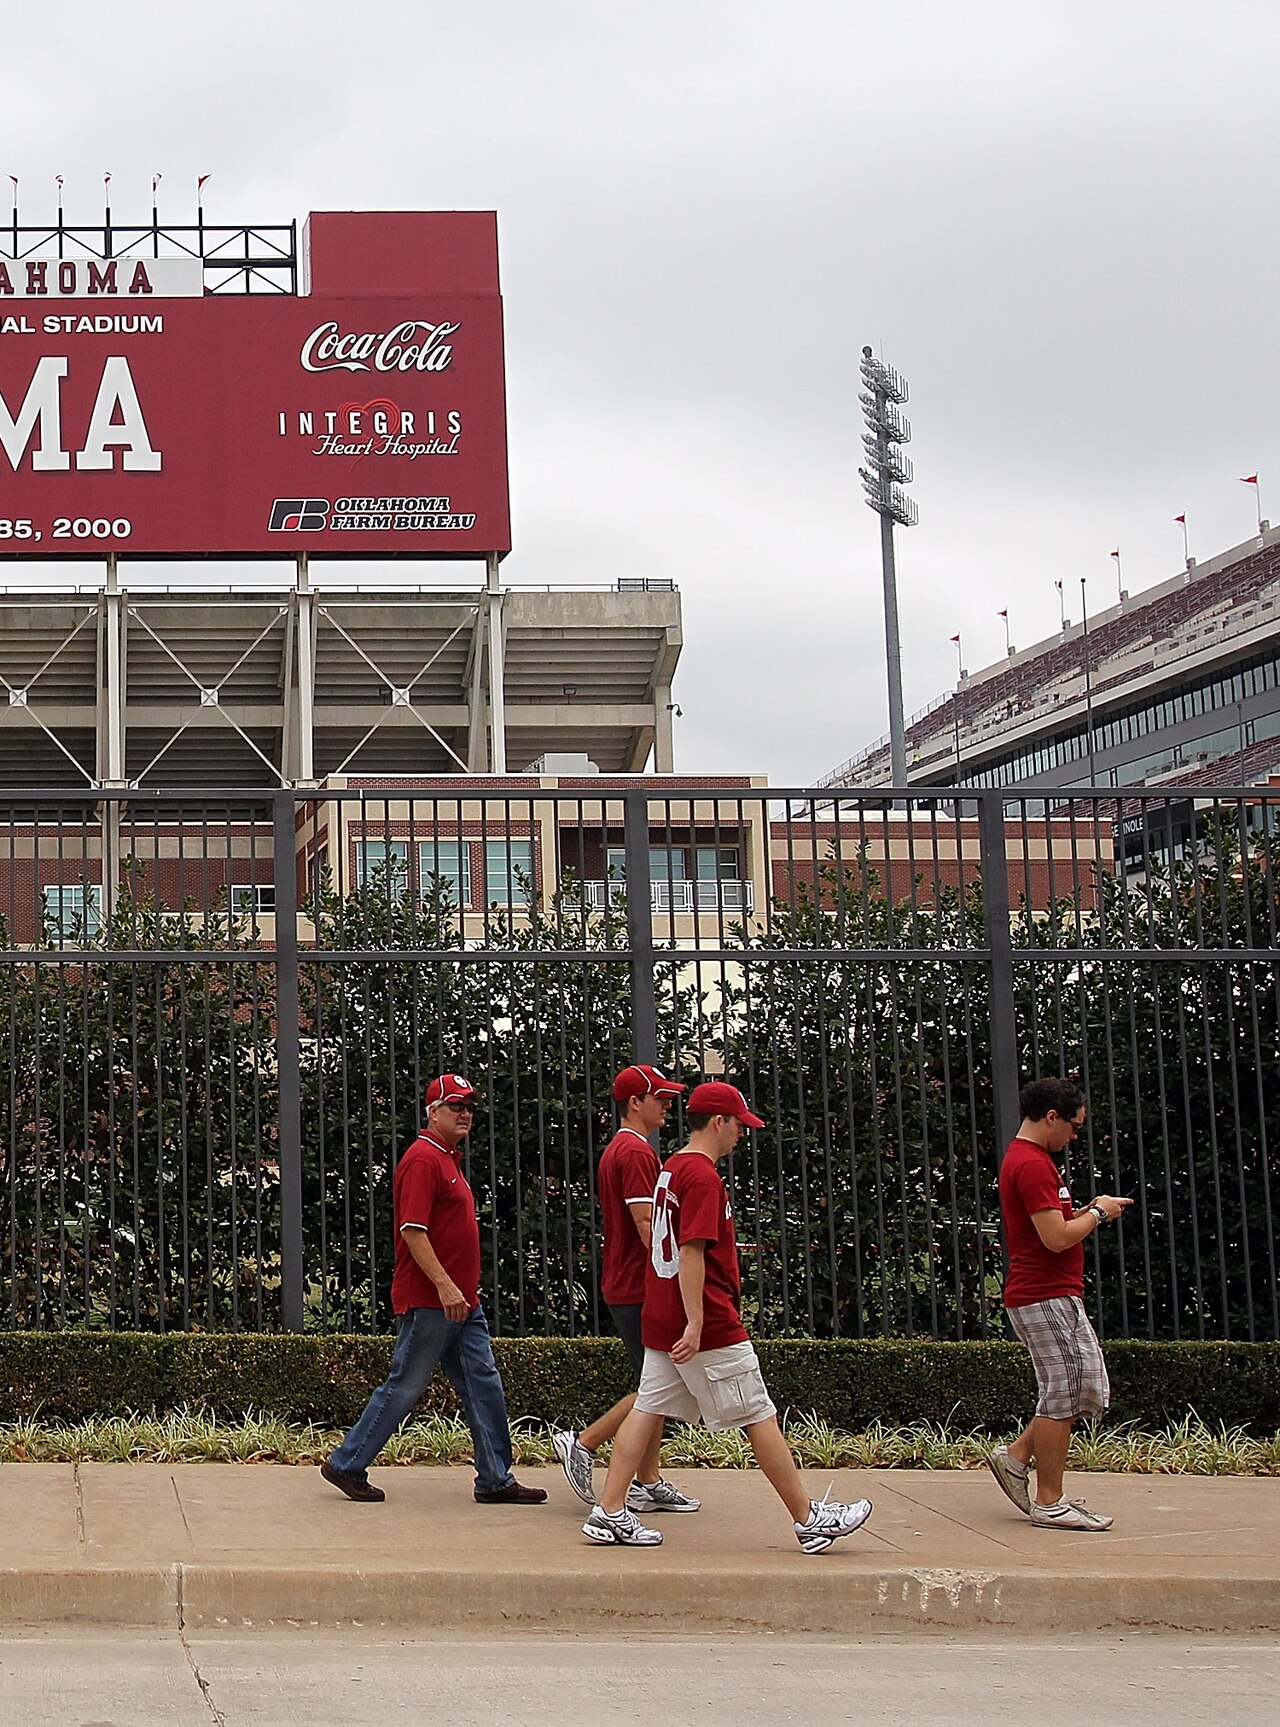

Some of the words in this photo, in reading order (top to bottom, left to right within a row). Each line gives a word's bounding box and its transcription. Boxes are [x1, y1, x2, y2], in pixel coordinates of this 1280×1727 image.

[43, 315, 164, 333] STADIUM
[300, 320, 462, 373] Coca-Cola
[278, 411, 461, 435] INTEGRIS
[312, 434, 375, 455] Heart
[334, 496, 451, 514] OKLAHOMA
[53, 518, 132, 539] 2000
[329, 514, 391, 531] FARM
[393, 513, 477, 531] BUREAU
